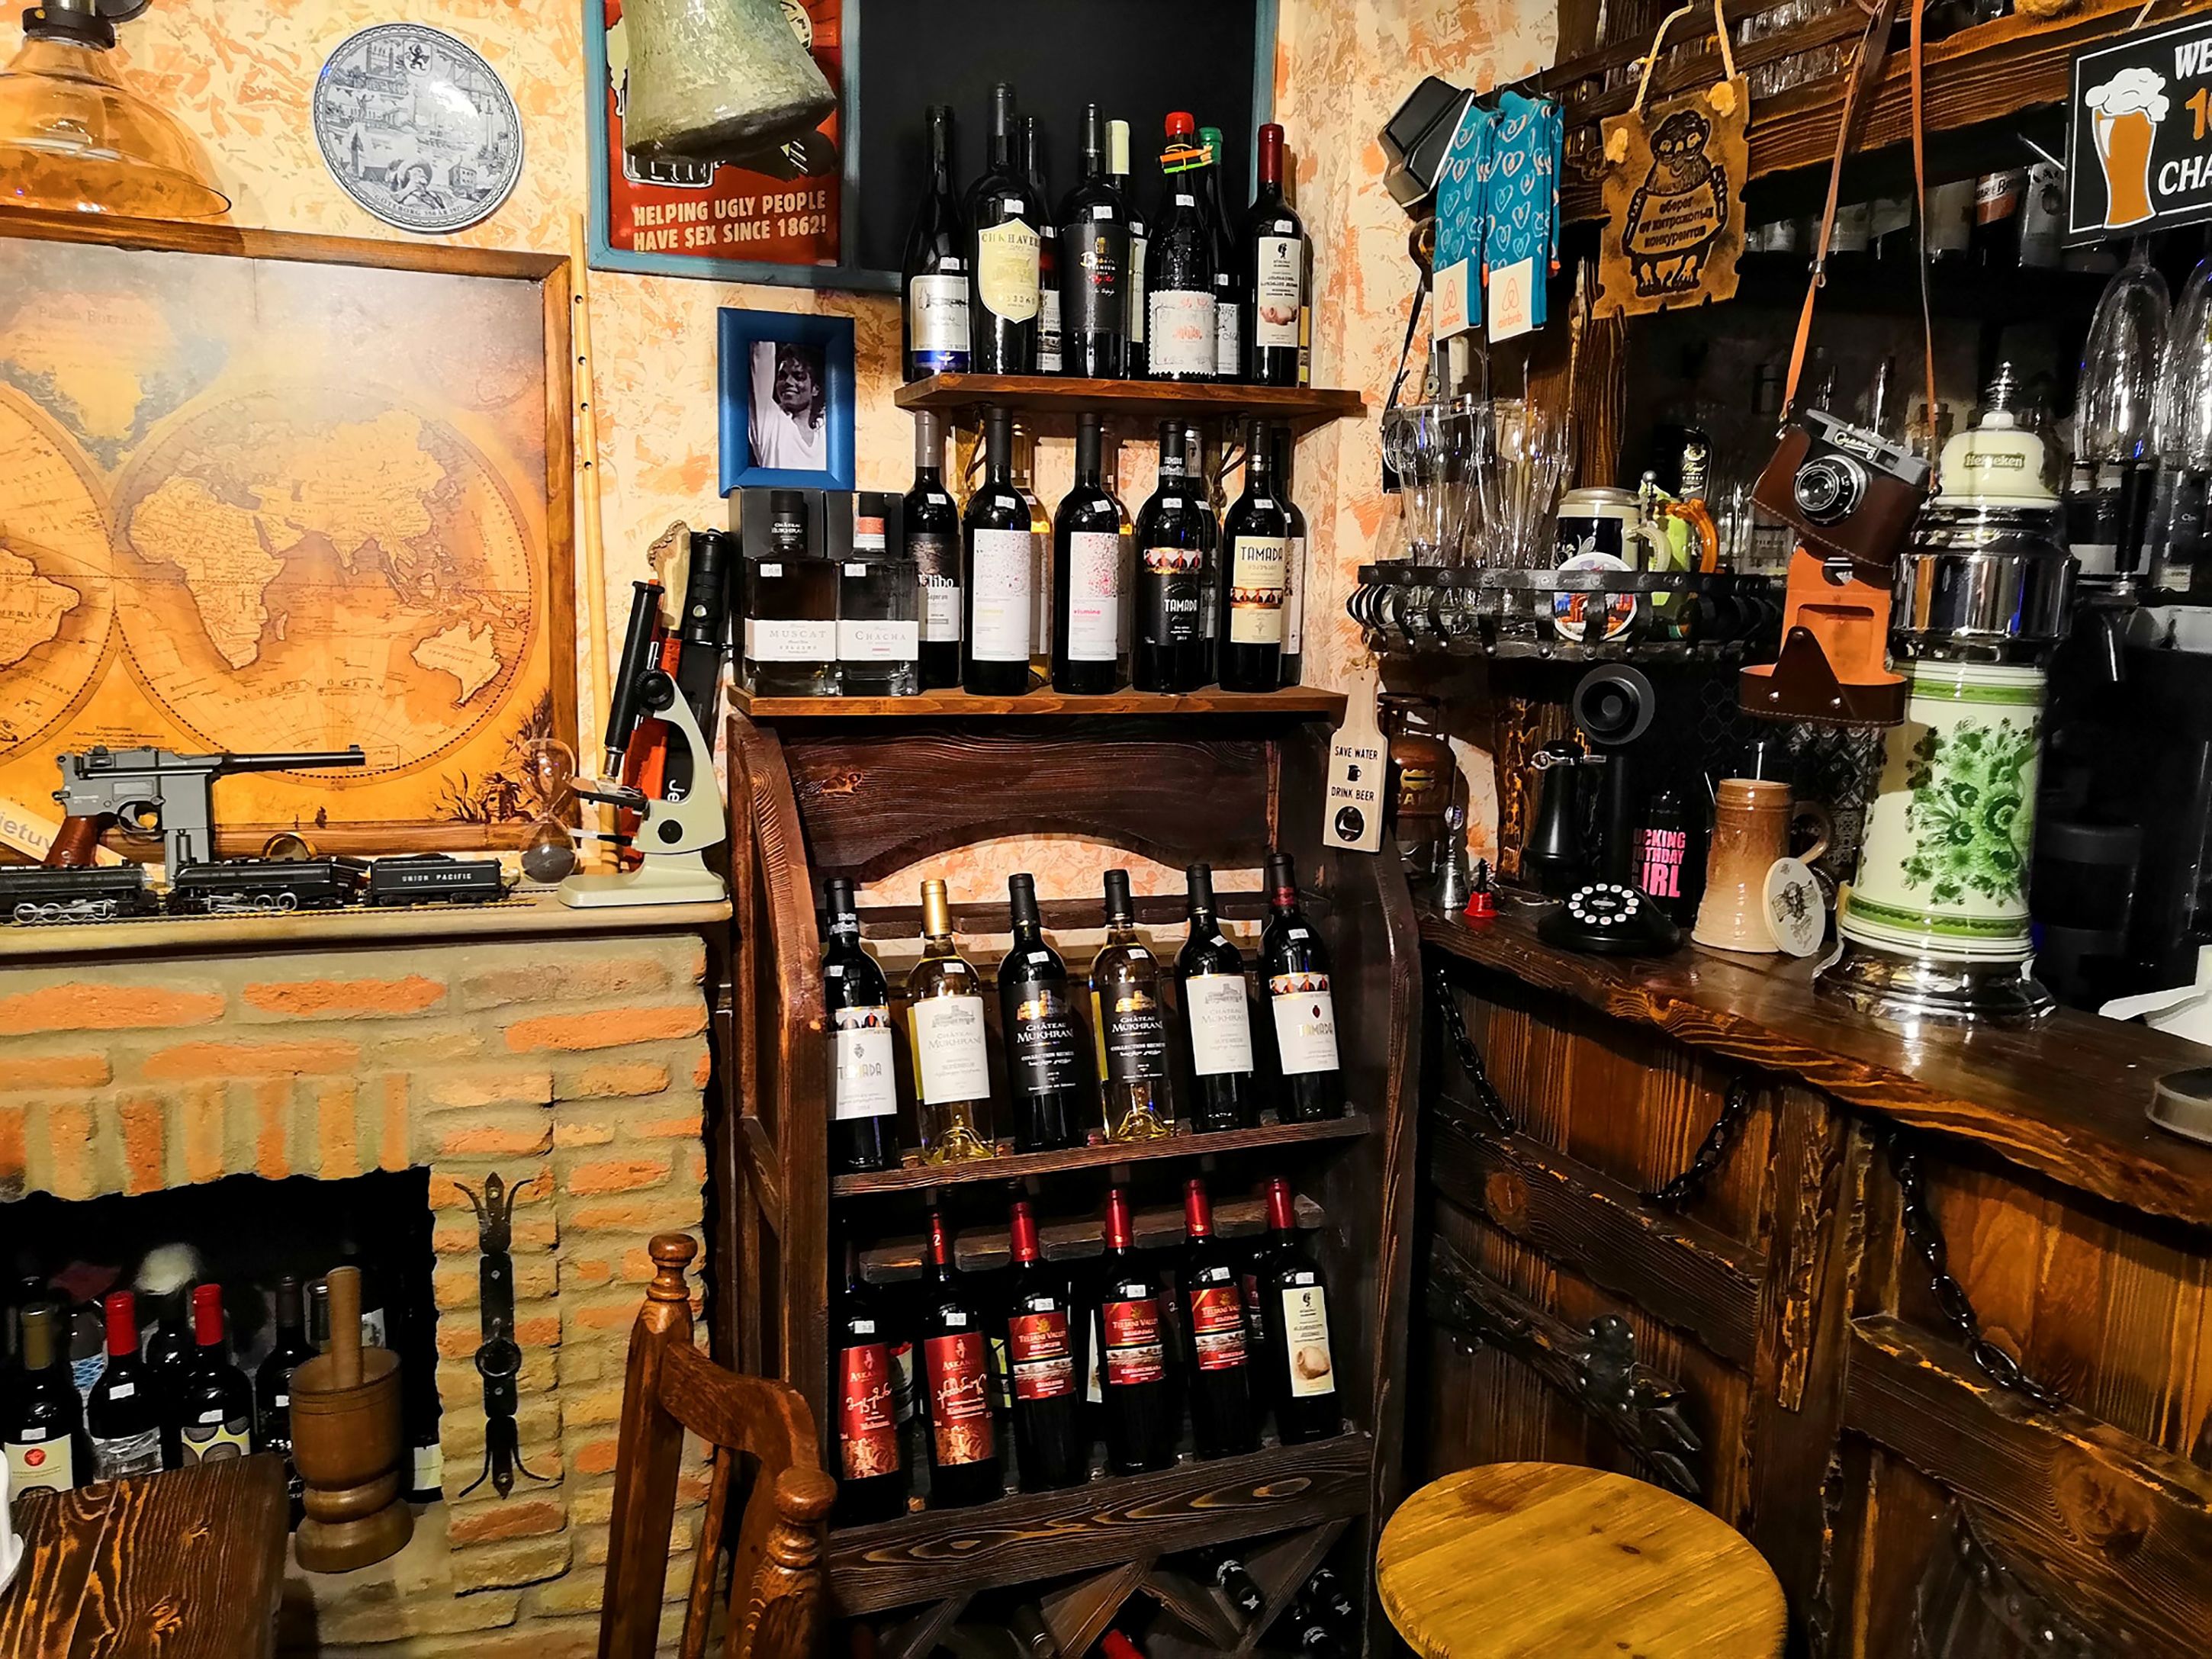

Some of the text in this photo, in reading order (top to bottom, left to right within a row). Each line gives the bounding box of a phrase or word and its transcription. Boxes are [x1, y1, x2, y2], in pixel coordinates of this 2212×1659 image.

[2185, 87, 2212, 140] 1
[634, 191, 825, 227] HELPING UGLY PEOPLE
[633, 214, 826, 251] HAVE SEX SINCE 1862!
[1645, 225, 1706, 248] конкурентов
[1965, 455, 2024, 468] Heeken
[1240, 546, 1283, 562] TAMADA
[1164, 599, 1198, 612] TAMADA
[770, 630, 827, 638] MUSCAT
[855, 631, 906, 641] CHACHA
[1335, 745, 1378, 760] SAVE WATER
[1331, 786, 1374, 802] DRINK BEER
[402, 873, 472, 883] UNION PACIFIC
